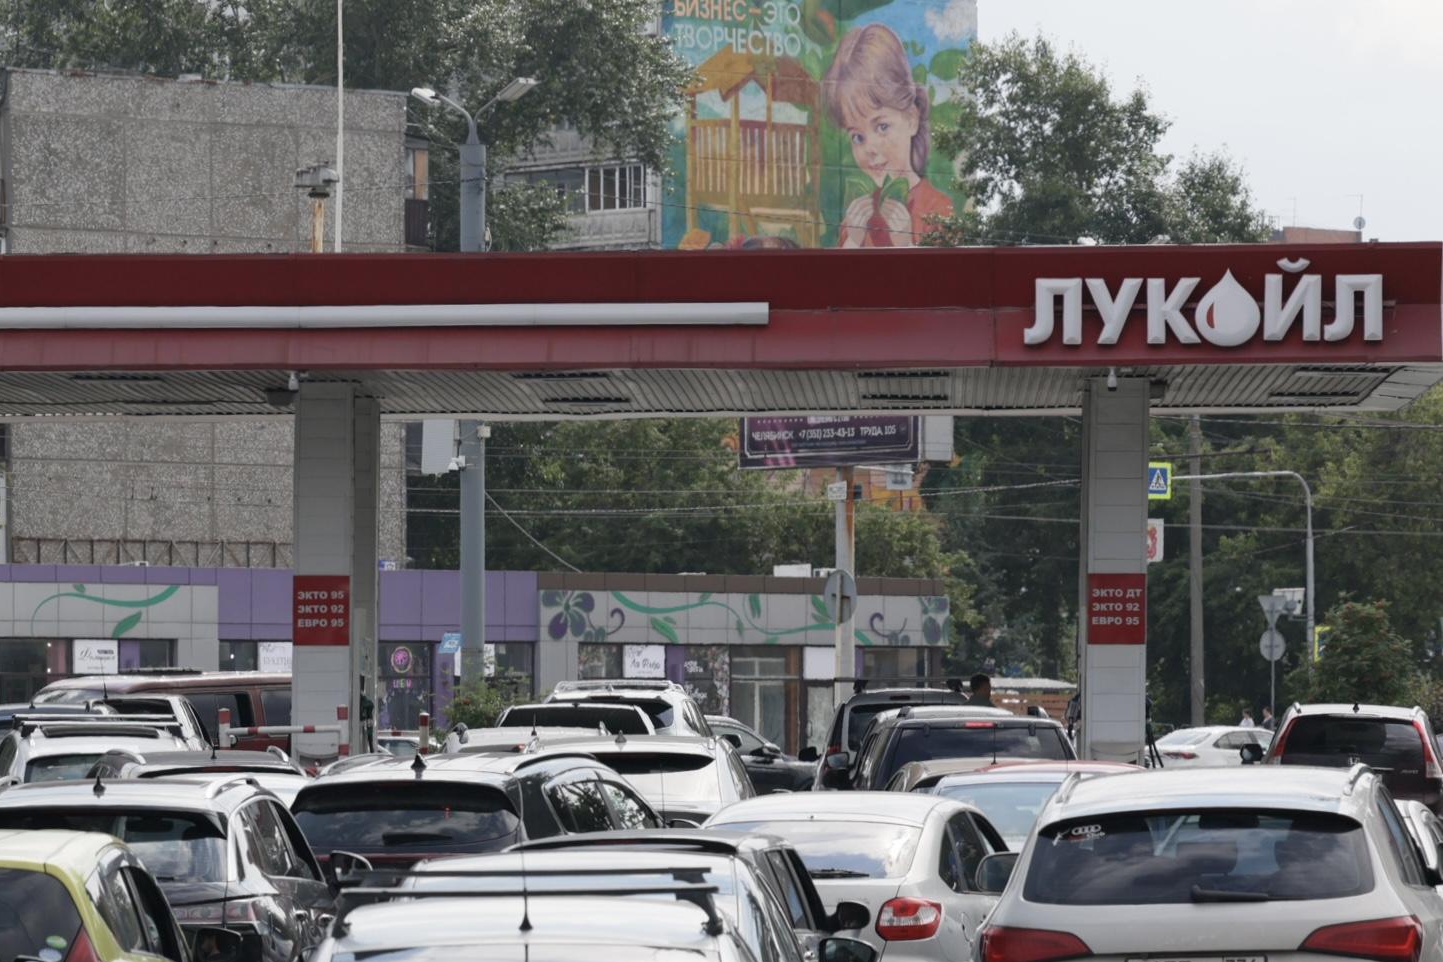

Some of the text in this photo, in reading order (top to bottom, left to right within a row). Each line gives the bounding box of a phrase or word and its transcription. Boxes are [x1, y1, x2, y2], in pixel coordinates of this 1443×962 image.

[674, 0, 746, 21] БИЗНЕС
[763, 2, 801, 25] ЭТО
[674, 23, 802, 56] ТВОРЧЕСТВО
[1023, 257, 1384, 347] ЛУКОЙЛ
[298, 591, 344, 600] ЭКТО 95
[1092, 588, 1143, 598] ЭКТО ДТ
[298, 605, 344, 613] ЭКТО 92
[1092, 603, 1140, 611] ЭКТО 92
[298, 619, 344, 627] ЕВРО 95
[1092, 617, 1140, 625] ЕВРО 95
